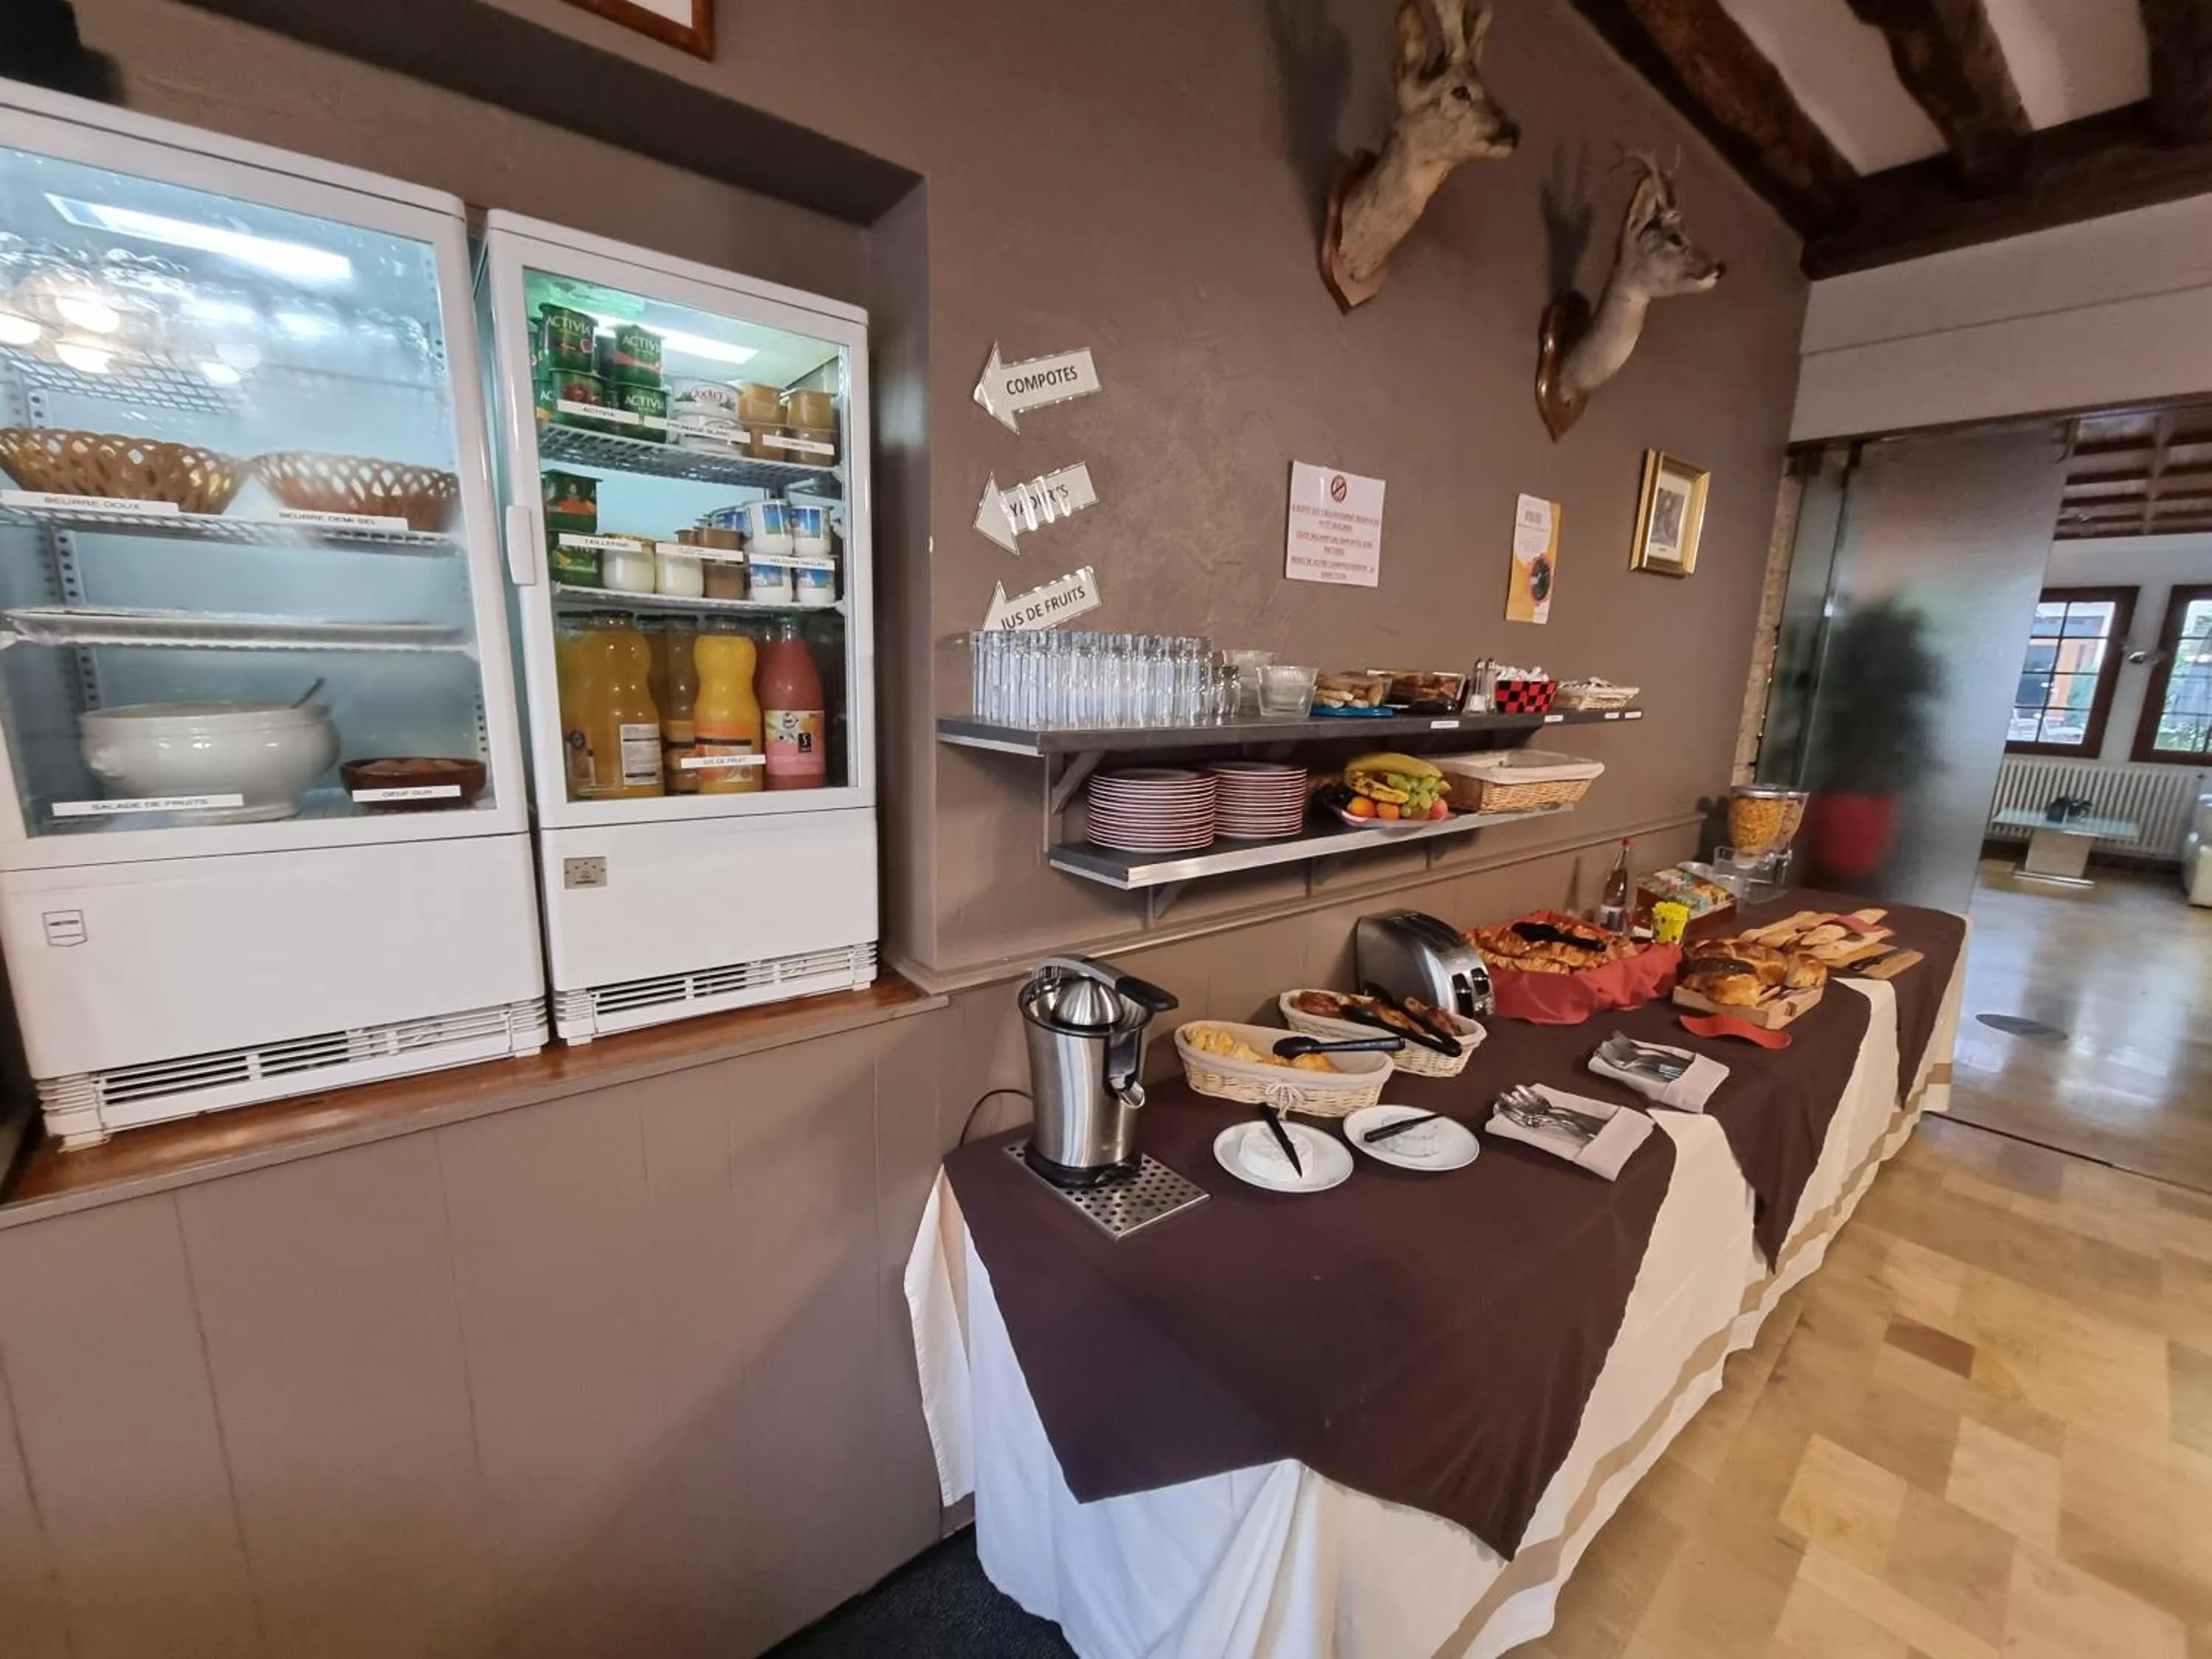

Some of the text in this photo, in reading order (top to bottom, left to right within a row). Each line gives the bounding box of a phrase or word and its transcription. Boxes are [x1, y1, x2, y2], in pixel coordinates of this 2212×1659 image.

[622, 334, 658, 353] ACTIVI
[1006, 365, 1077, 395] COMPOTES
[625, 394, 664, 411] ACTIVI
[44, 496, 140, 509] BEURRE DOUX
[1001, 585, 1085, 632] JUS DE FRUITS
[92, 802, 142, 811] SALADE
[164, 799, 208, 808] FRUITS
